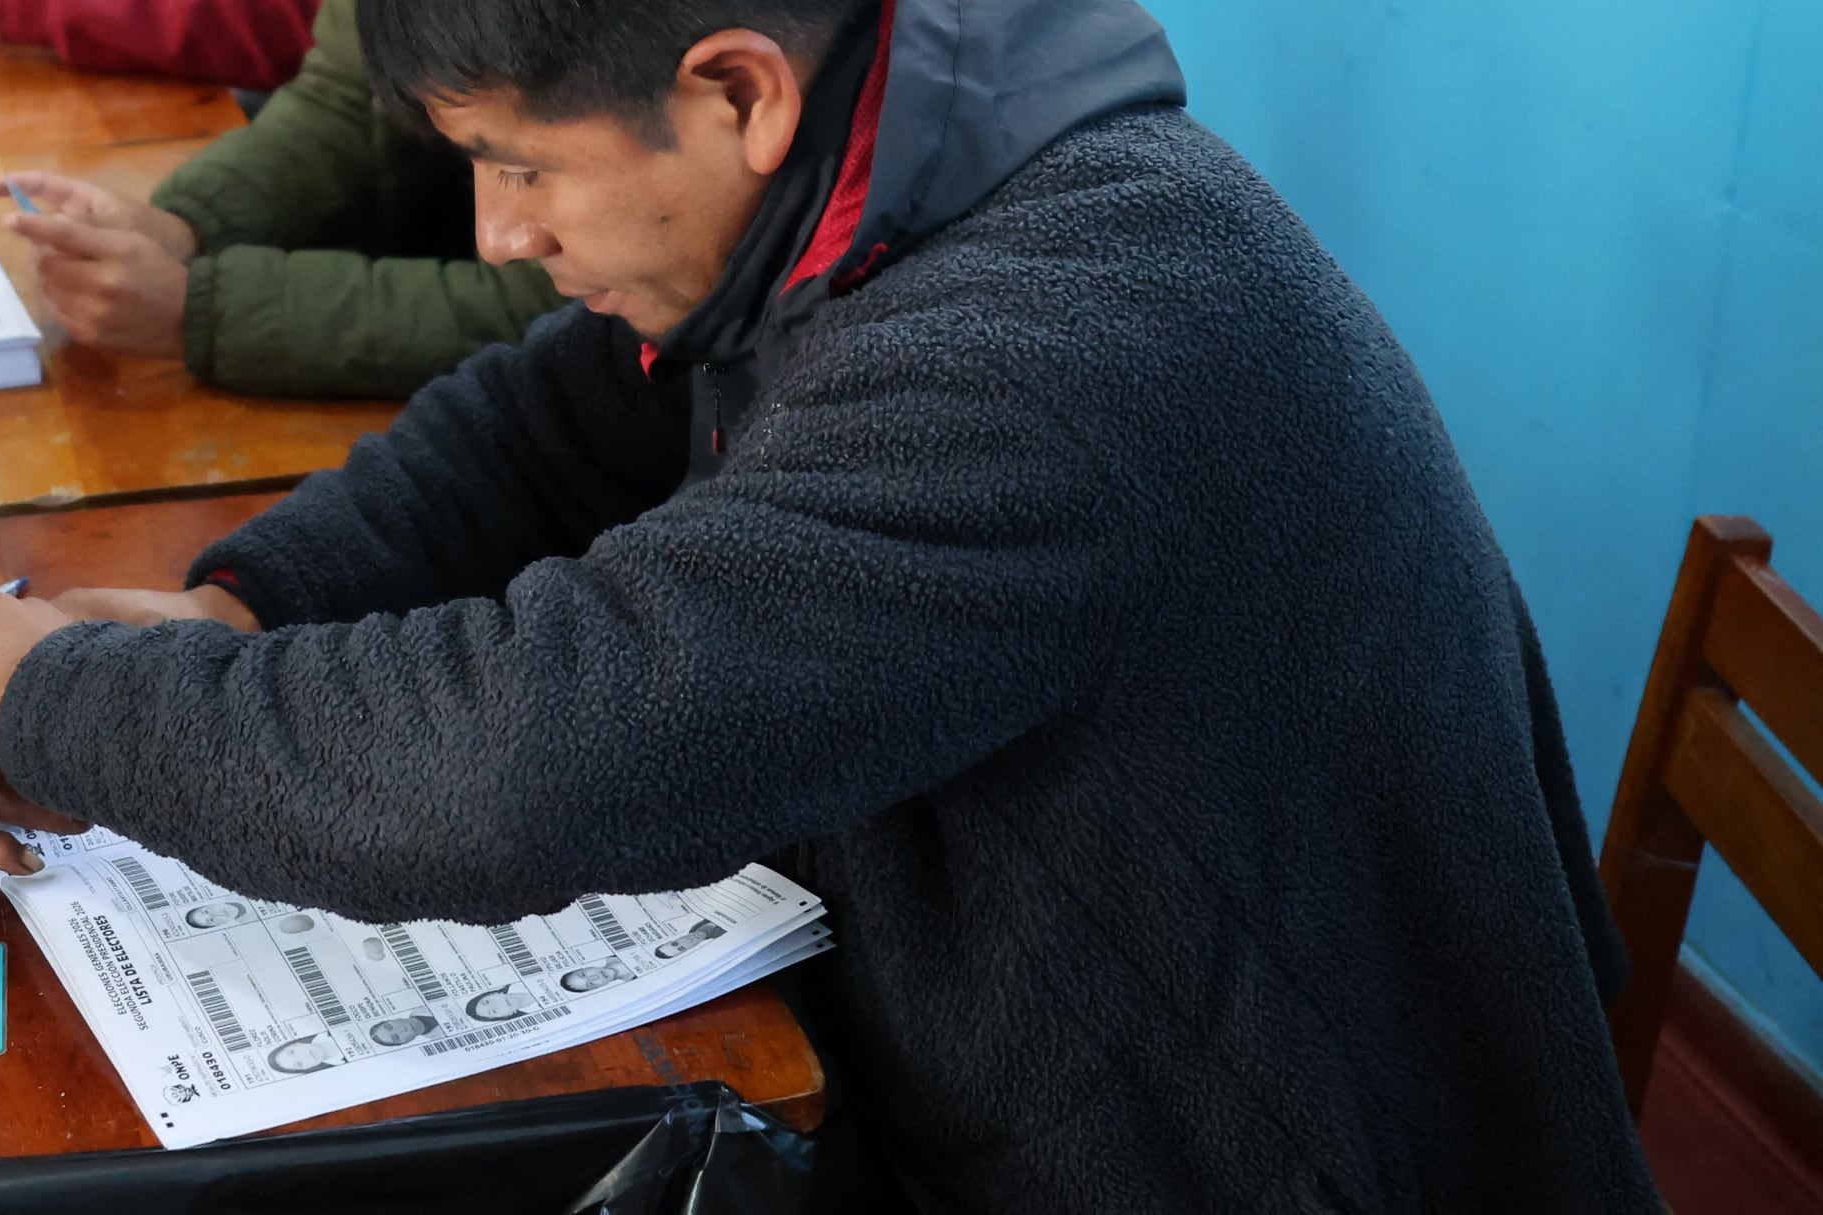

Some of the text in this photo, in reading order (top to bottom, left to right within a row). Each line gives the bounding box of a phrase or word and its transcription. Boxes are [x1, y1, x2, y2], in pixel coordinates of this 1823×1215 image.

[70, 900, 85, 915] 2026
[78, 915, 111, 960] PRESIDENCIAL
[67, 917, 128, 1015] ELECCIONES GENERALES 2026
[92, 914, 152, 1005] LISTA DE ELECTORES
[102, 960, 130, 995] ELECCIÓN
[122, 995, 149, 1030] SEGUNDA
[193, 1025, 208, 1043] CUSCO
[344, 1046, 356, 1057] 192
[166, 1053, 191, 1080] ONPE
[200, 1051, 231, 1089] 018430
